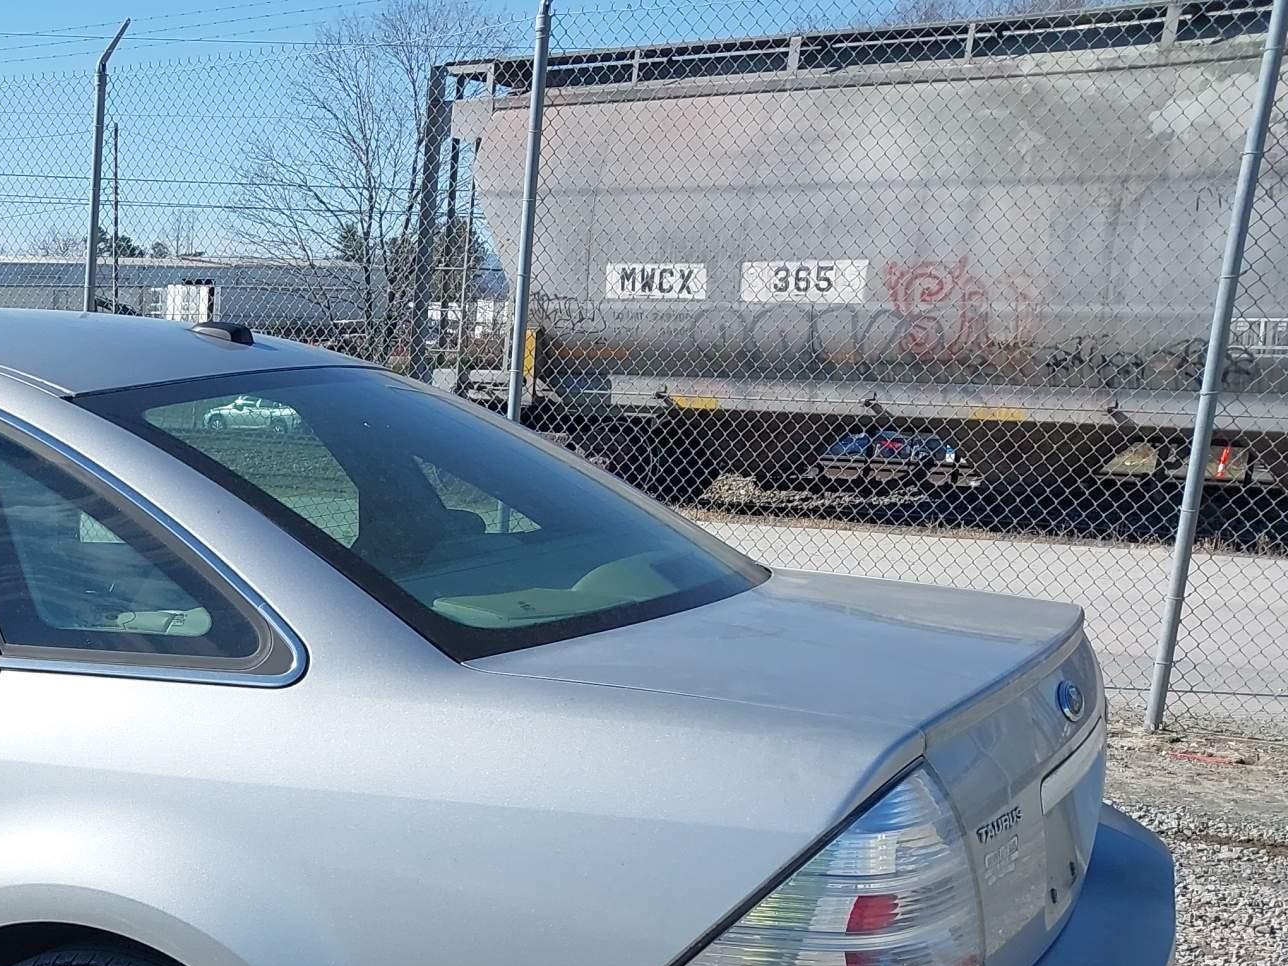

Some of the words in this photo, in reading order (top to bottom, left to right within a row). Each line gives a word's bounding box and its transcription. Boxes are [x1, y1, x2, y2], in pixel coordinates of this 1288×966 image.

[619, 267, 693, 294] MWCX
[772, 266, 834, 292] 365
[976, 806, 1023, 844] TAURUS
